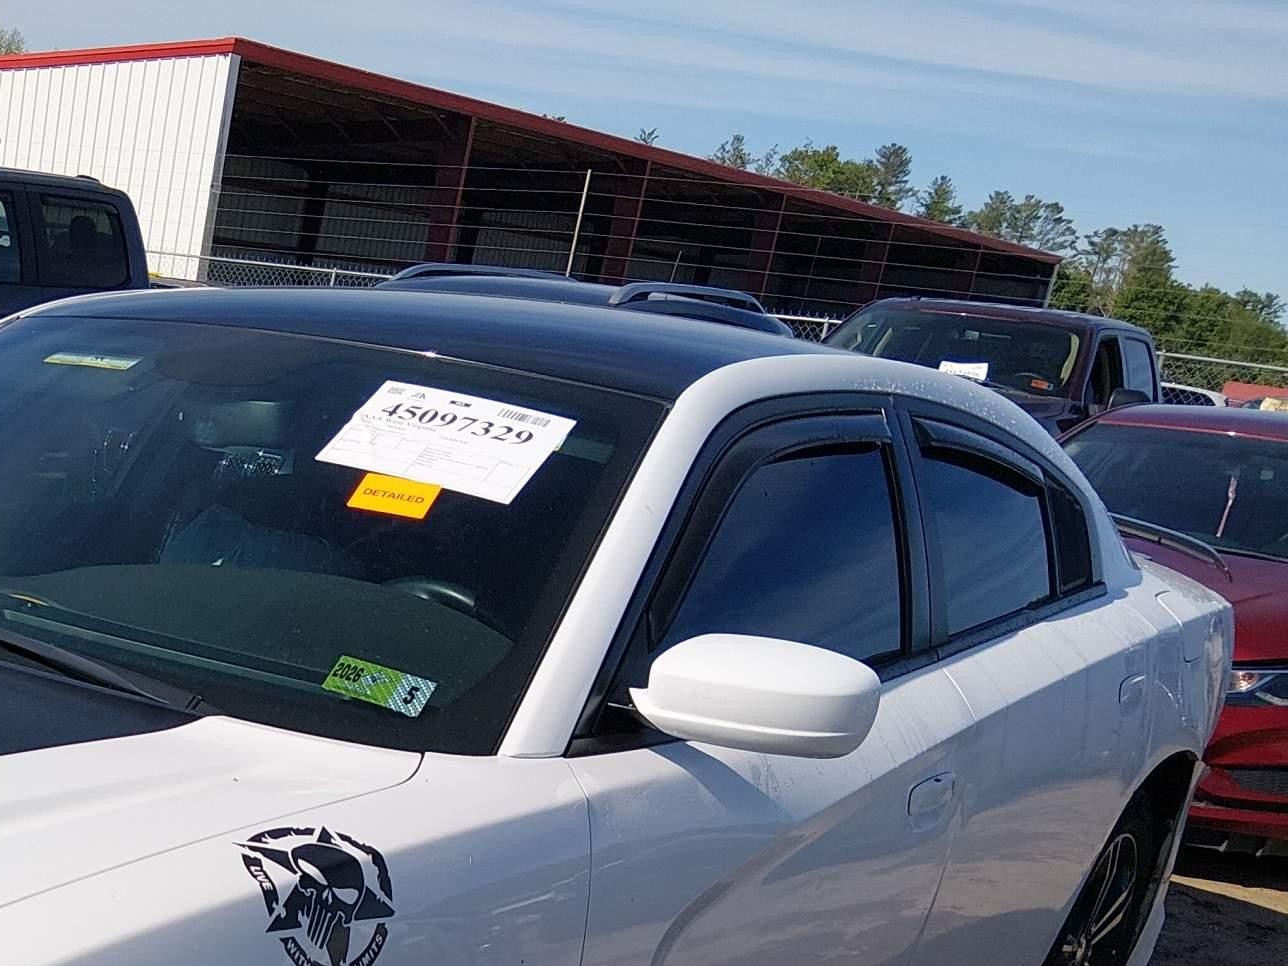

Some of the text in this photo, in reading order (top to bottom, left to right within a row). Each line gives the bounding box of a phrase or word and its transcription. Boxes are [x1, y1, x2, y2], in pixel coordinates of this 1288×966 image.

[381, 402, 534, 445] 45097329
[363, 487, 425, 504] DETAILED
[332, 662, 364, 683] 2026
[402, 686, 420, 705] 5
[249, 864, 274, 892] LIVE
